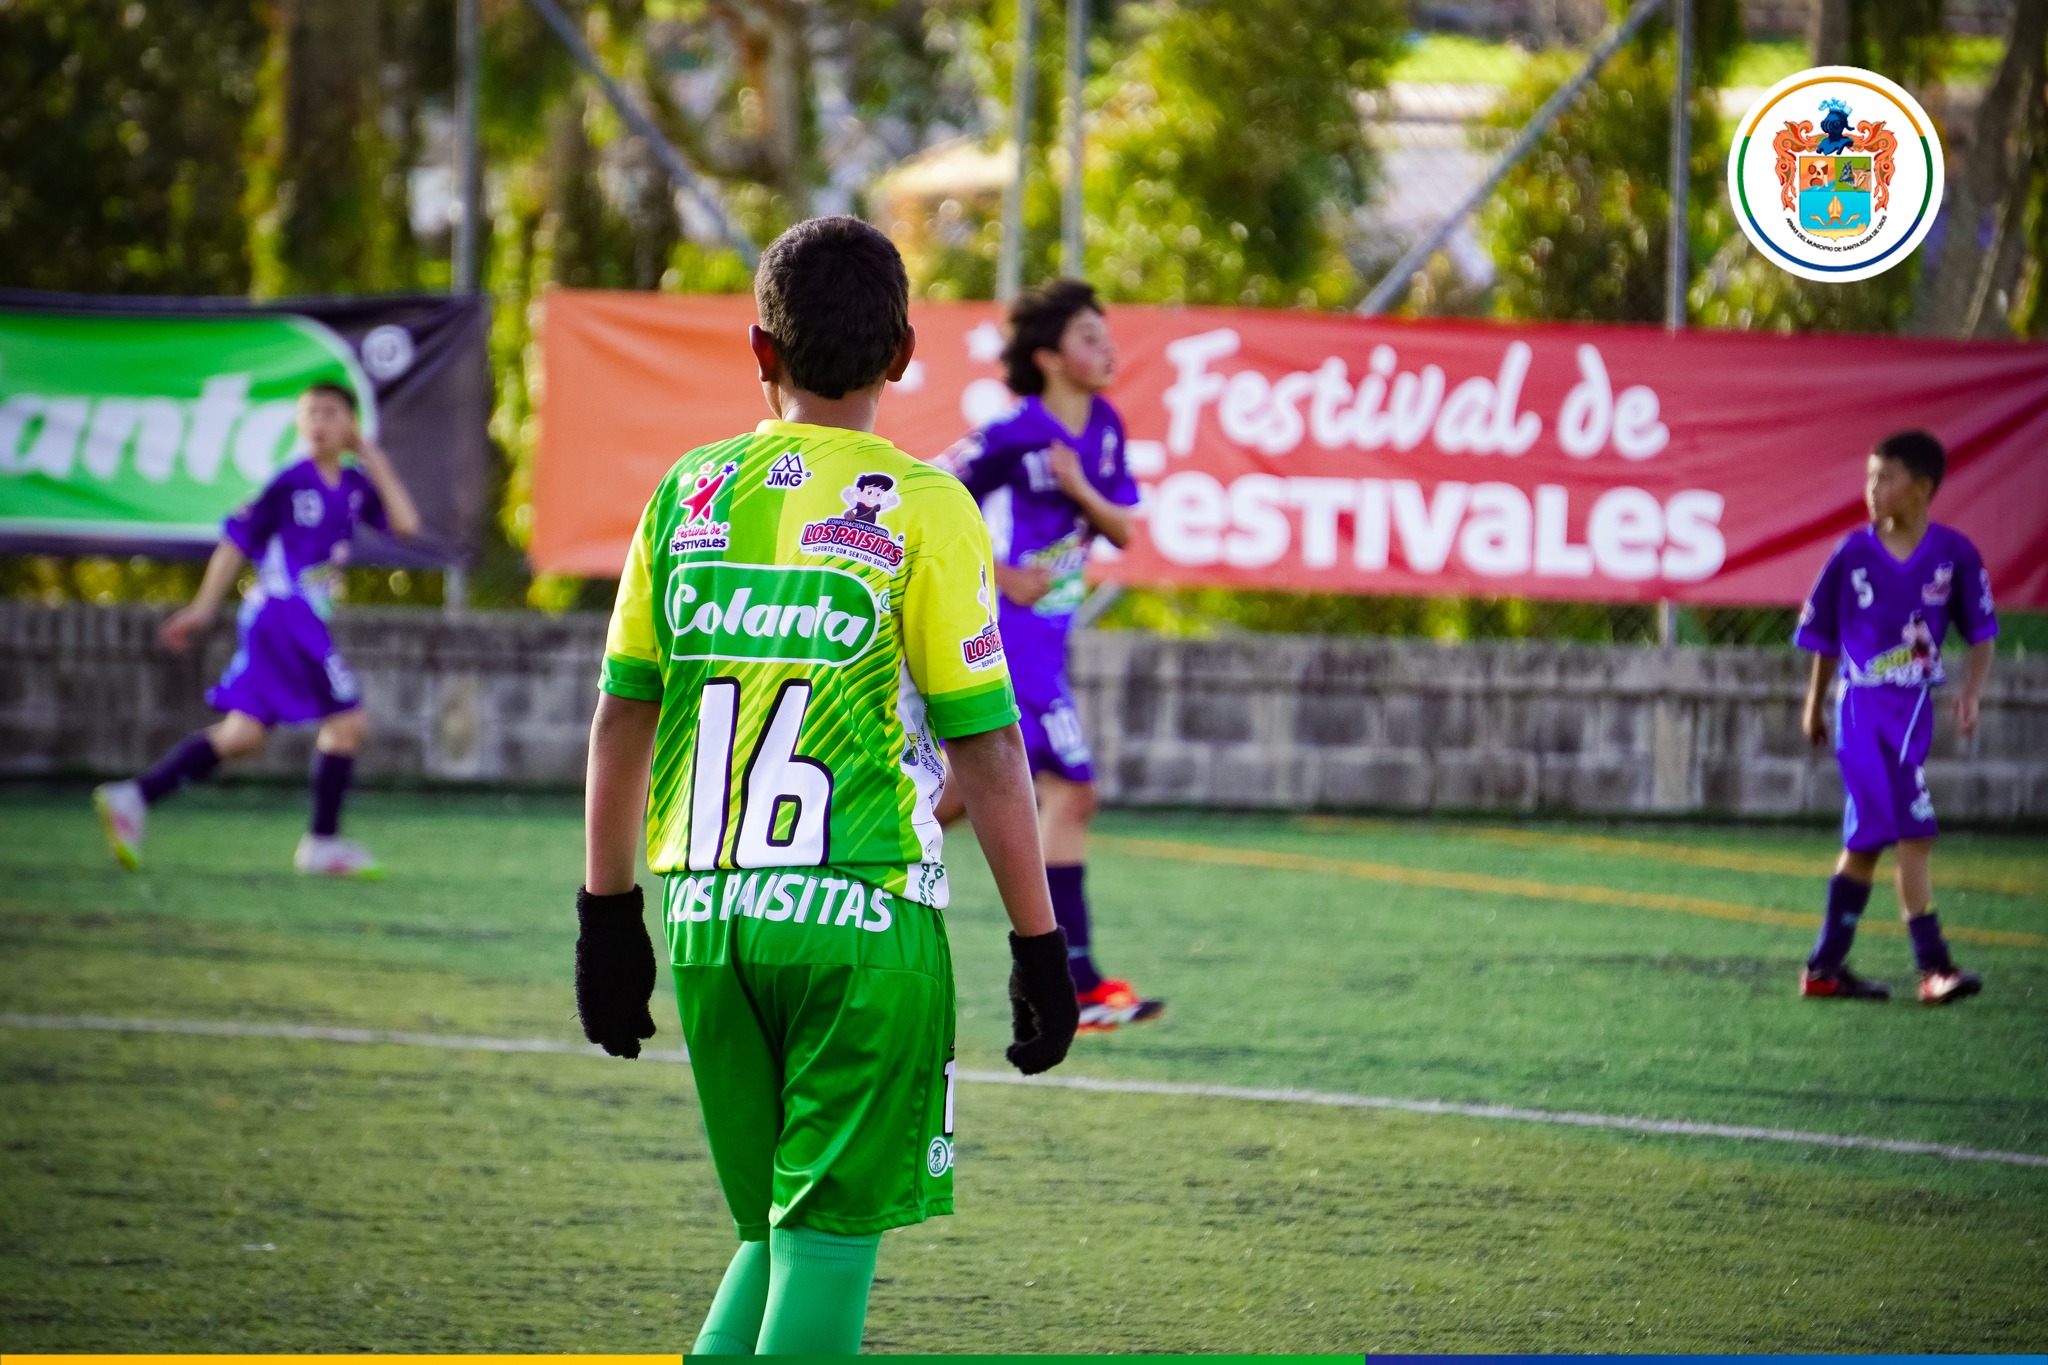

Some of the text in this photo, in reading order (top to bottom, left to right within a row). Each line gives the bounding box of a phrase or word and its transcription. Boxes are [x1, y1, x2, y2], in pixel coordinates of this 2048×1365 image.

[1164, 327, 1670, 461] Festival de
[766, 471, 803, 487] JMG
[709, 523, 721, 535] de
[803, 524, 904, 565] LOS PAISITAS
[1851, 566, 1874, 609] 5
[673, 582, 869, 648] Colanta
[965, 634, 992, 661] LOS
[686, 675, 836, 872] 16
[718, 871, 894, 933] PAISITAS
